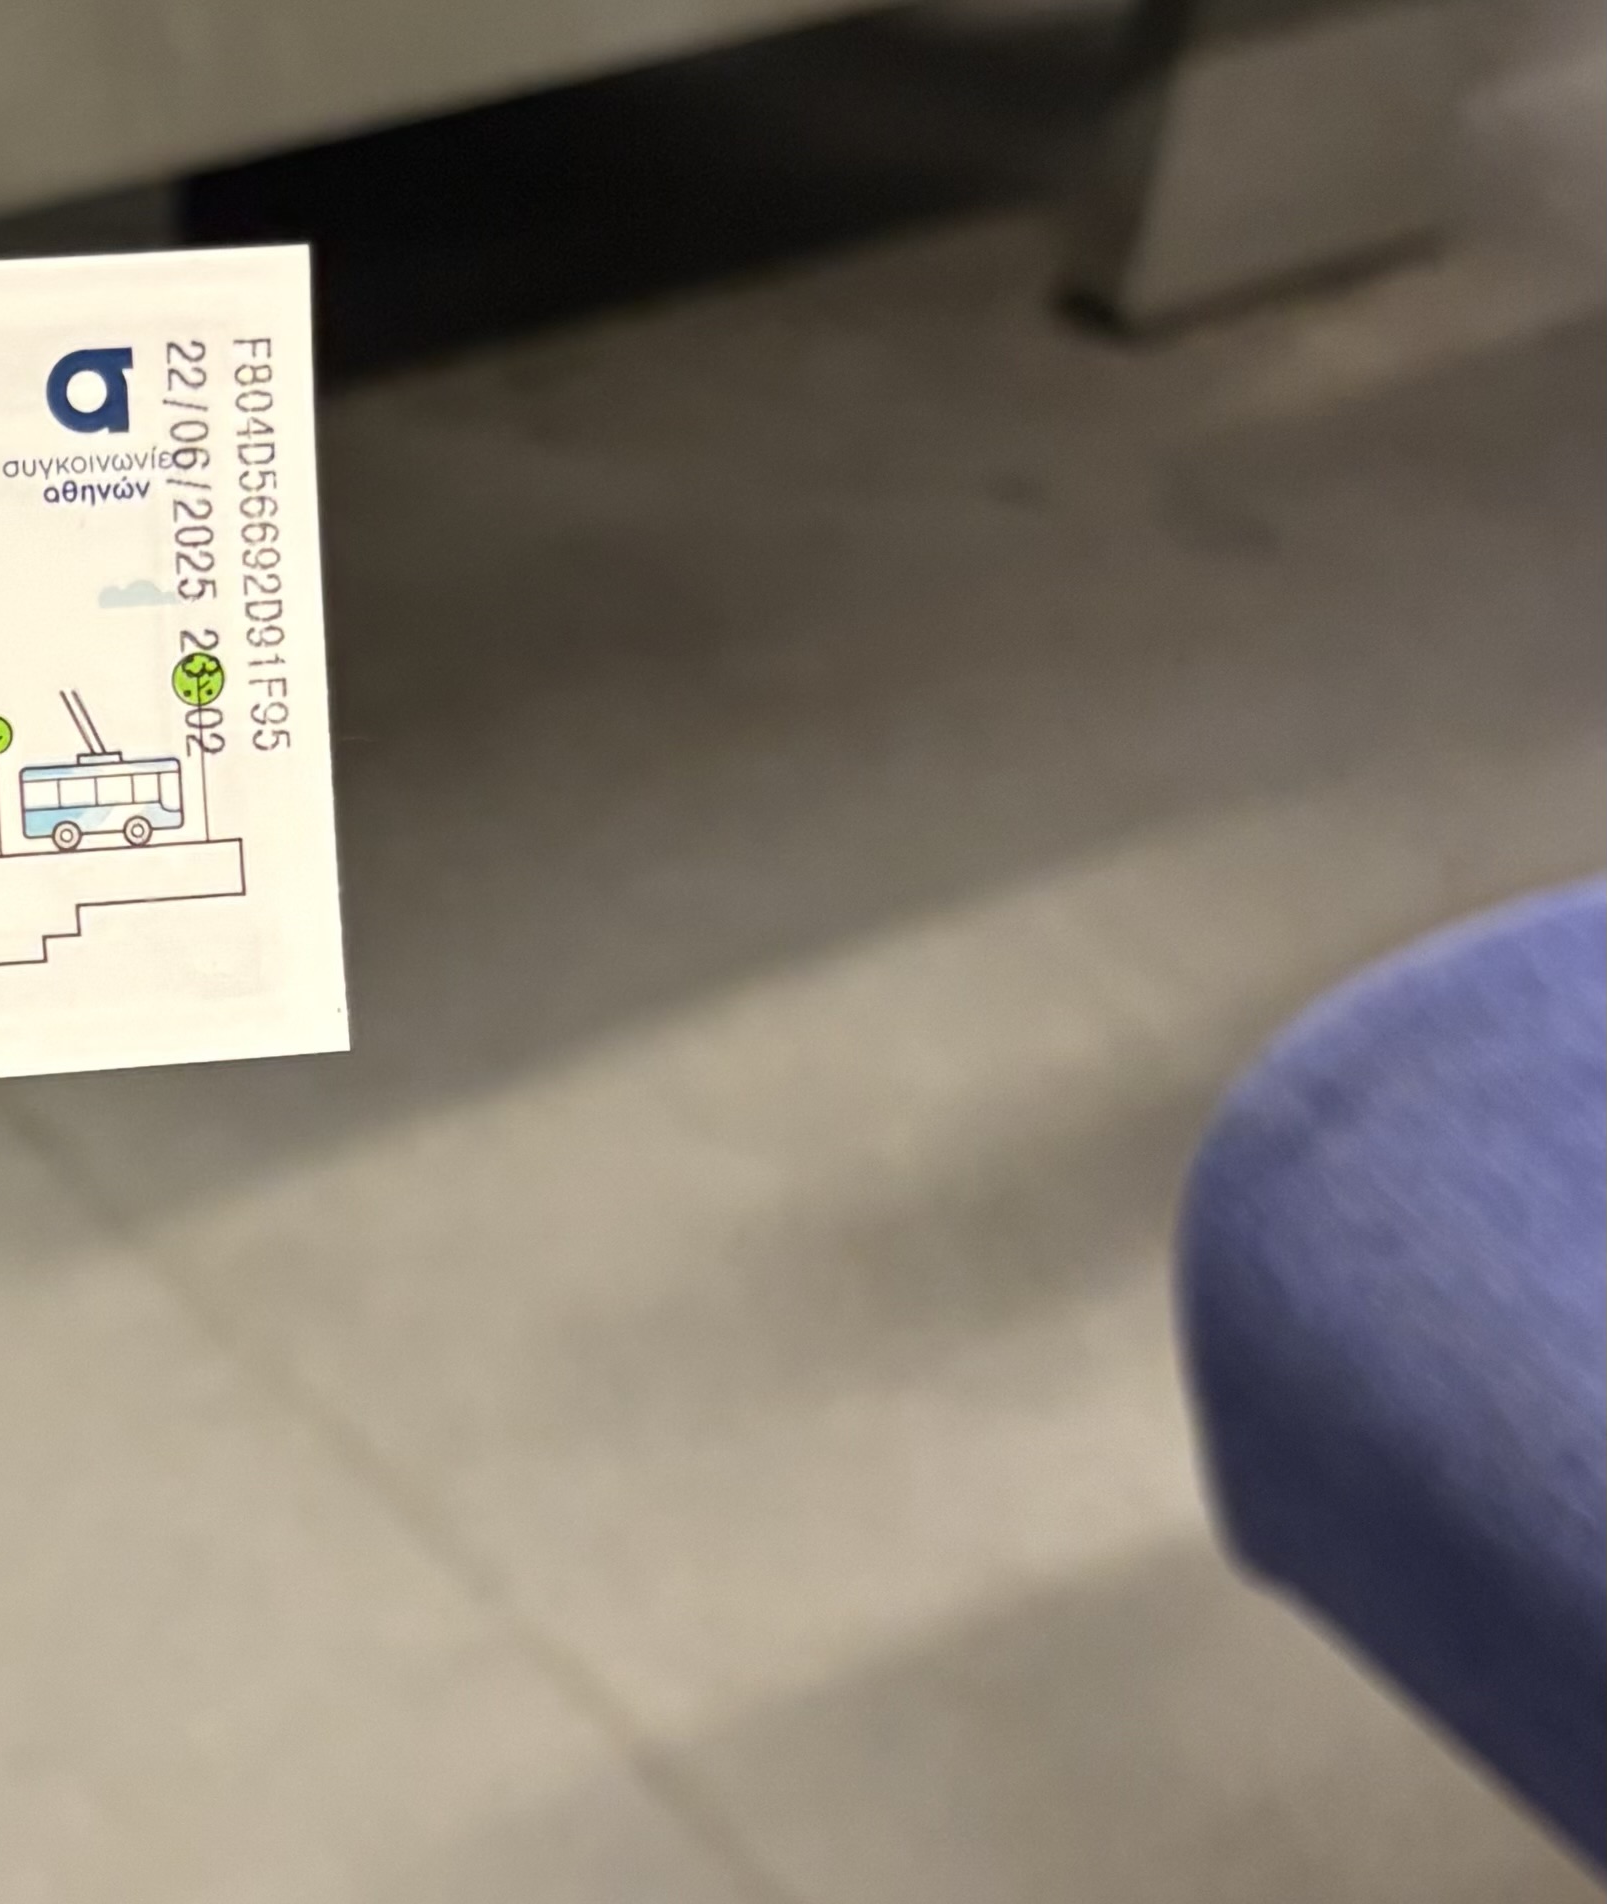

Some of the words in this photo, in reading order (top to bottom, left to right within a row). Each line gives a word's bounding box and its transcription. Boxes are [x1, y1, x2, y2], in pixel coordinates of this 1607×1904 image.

[43, 476, 151, 507] αθηνών
[162, 339, 217, 602] 22/06/2025
[233, 337, 291, 751] F804D56692D91F95
[179, 628, 226, 758] 23:02
